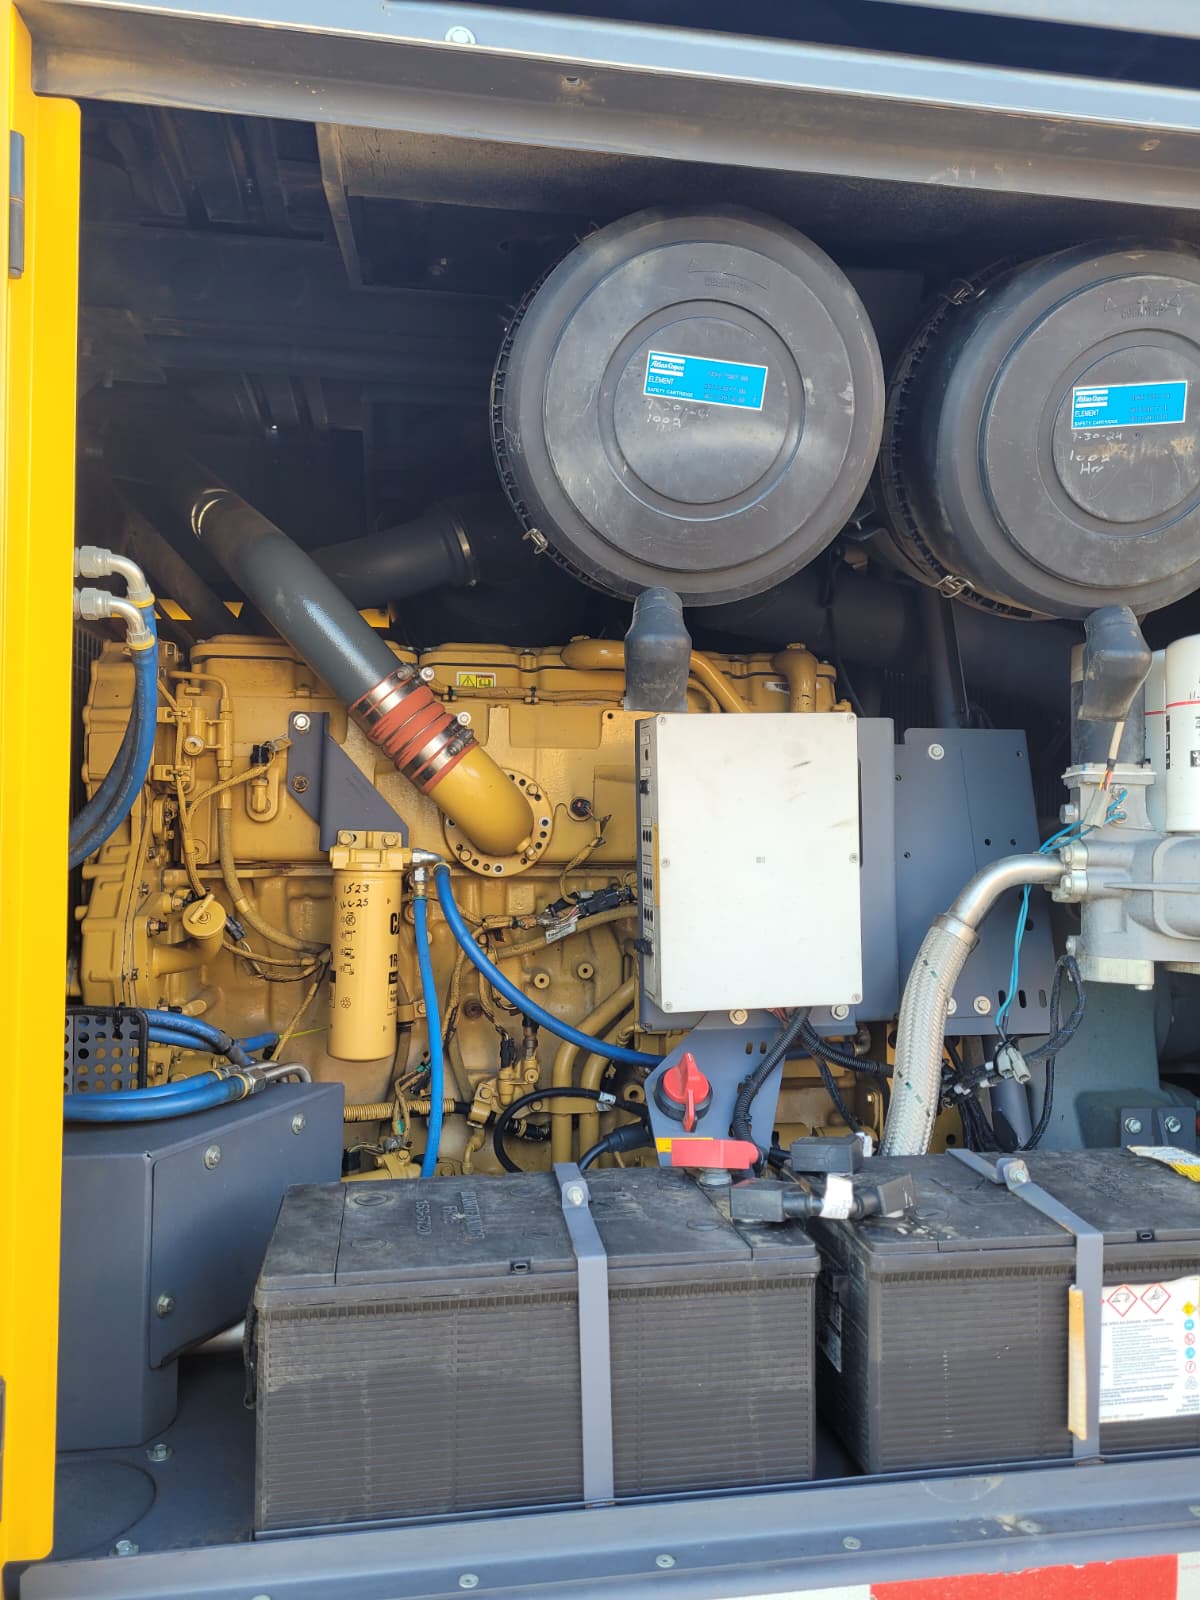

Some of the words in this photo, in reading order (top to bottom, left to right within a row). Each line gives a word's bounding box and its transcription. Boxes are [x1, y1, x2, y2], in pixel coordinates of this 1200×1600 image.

[651, 360, 668, 369] Atlas
[648, 376, 675, 385] ELEMENT
[1074, 409, 1099, 418] ELEMENT
[344, 882, 370, 894] 1523
